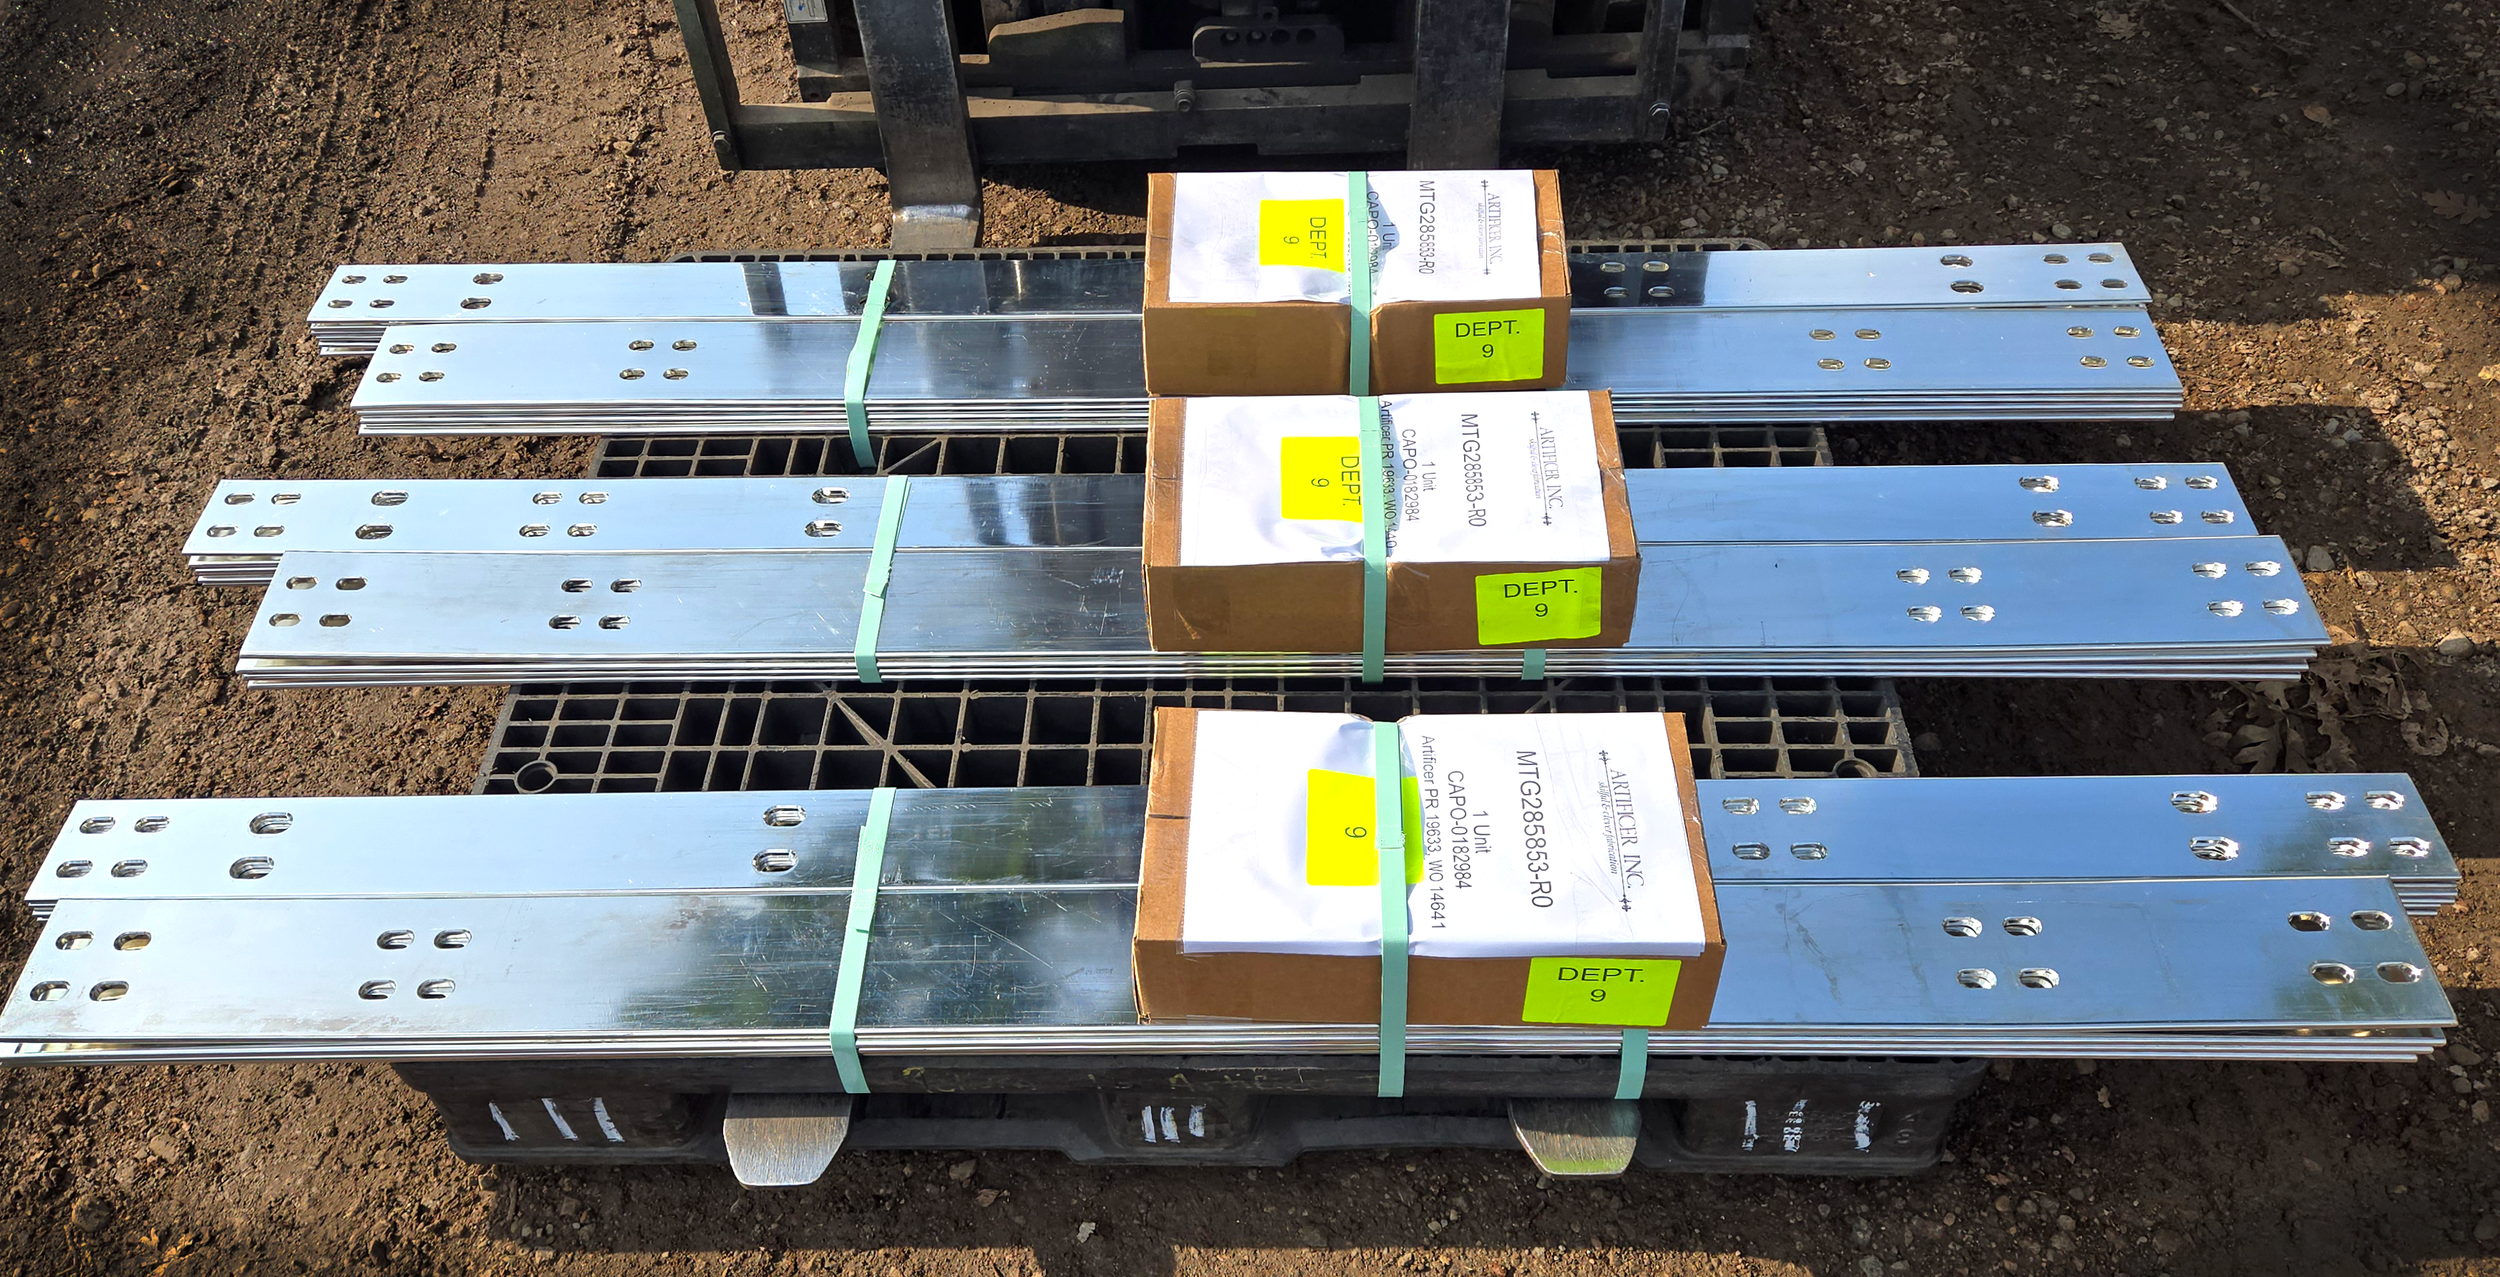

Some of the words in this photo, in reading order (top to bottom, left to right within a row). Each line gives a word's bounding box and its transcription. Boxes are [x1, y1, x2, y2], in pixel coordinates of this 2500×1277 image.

[1418, 181, 1435, 274] MTG285853-R0
[1488, 193, 1501, 242] ARTIFICER
[1285, 235, 1300, 245] 9
[1309, 216, 1327, 260] DEPT.
[1454, 319, 1520, 337] DEPT.
[1482, 343, 1494, 359] 9
[1380, 400, 1393, 440] Artificer
[1382, 444, 1394, 459] PR
[1540, 427, 1560, 481] ARTIFICER
[1311, 478, 1330, 487] 9
[1340, 456, 1361, 506] DEPT.
[1402, 429, 1420, 521] CAPO-0182984
[1422, 472, 1436, 491] Unit
[1461, 414, 1487, 527] MTG285853-R0
[1548, 485, 1563, 509] INC.
[1384, 499, 1397, 520] WO
[1504, 579, 1578, 598] DEPT.
[1535, 603, 1548, 617] 9
[1422, 736, 1436, 784] Artificer
[1424, 789, 1439, 809] PR
[1597, 781, 1611, 803] skilful
[1344, 826, 1367, 839] 9
[1447, 771, 1472, 889] CAPO-0182984
[1516, 750, 1553, 908] MTG285853-R0
[1602, 811, 1612, 834] clever
[1610, 769, 1638, 846] ARTIFICER
[1624, 854, 1644, 889] INC.
[1426, 814, 1442, 856] 19633,
[1473, 825, 1491, 854] Unit
[1603, 833, 1619, 874] fabrication
[1428, 860, 1443, 882] WO
[1430, 887, 1446, 929] 14641
[1558, 967, 1644, 983] DEPT.
[1590, 988, 1606, 1003] 9
